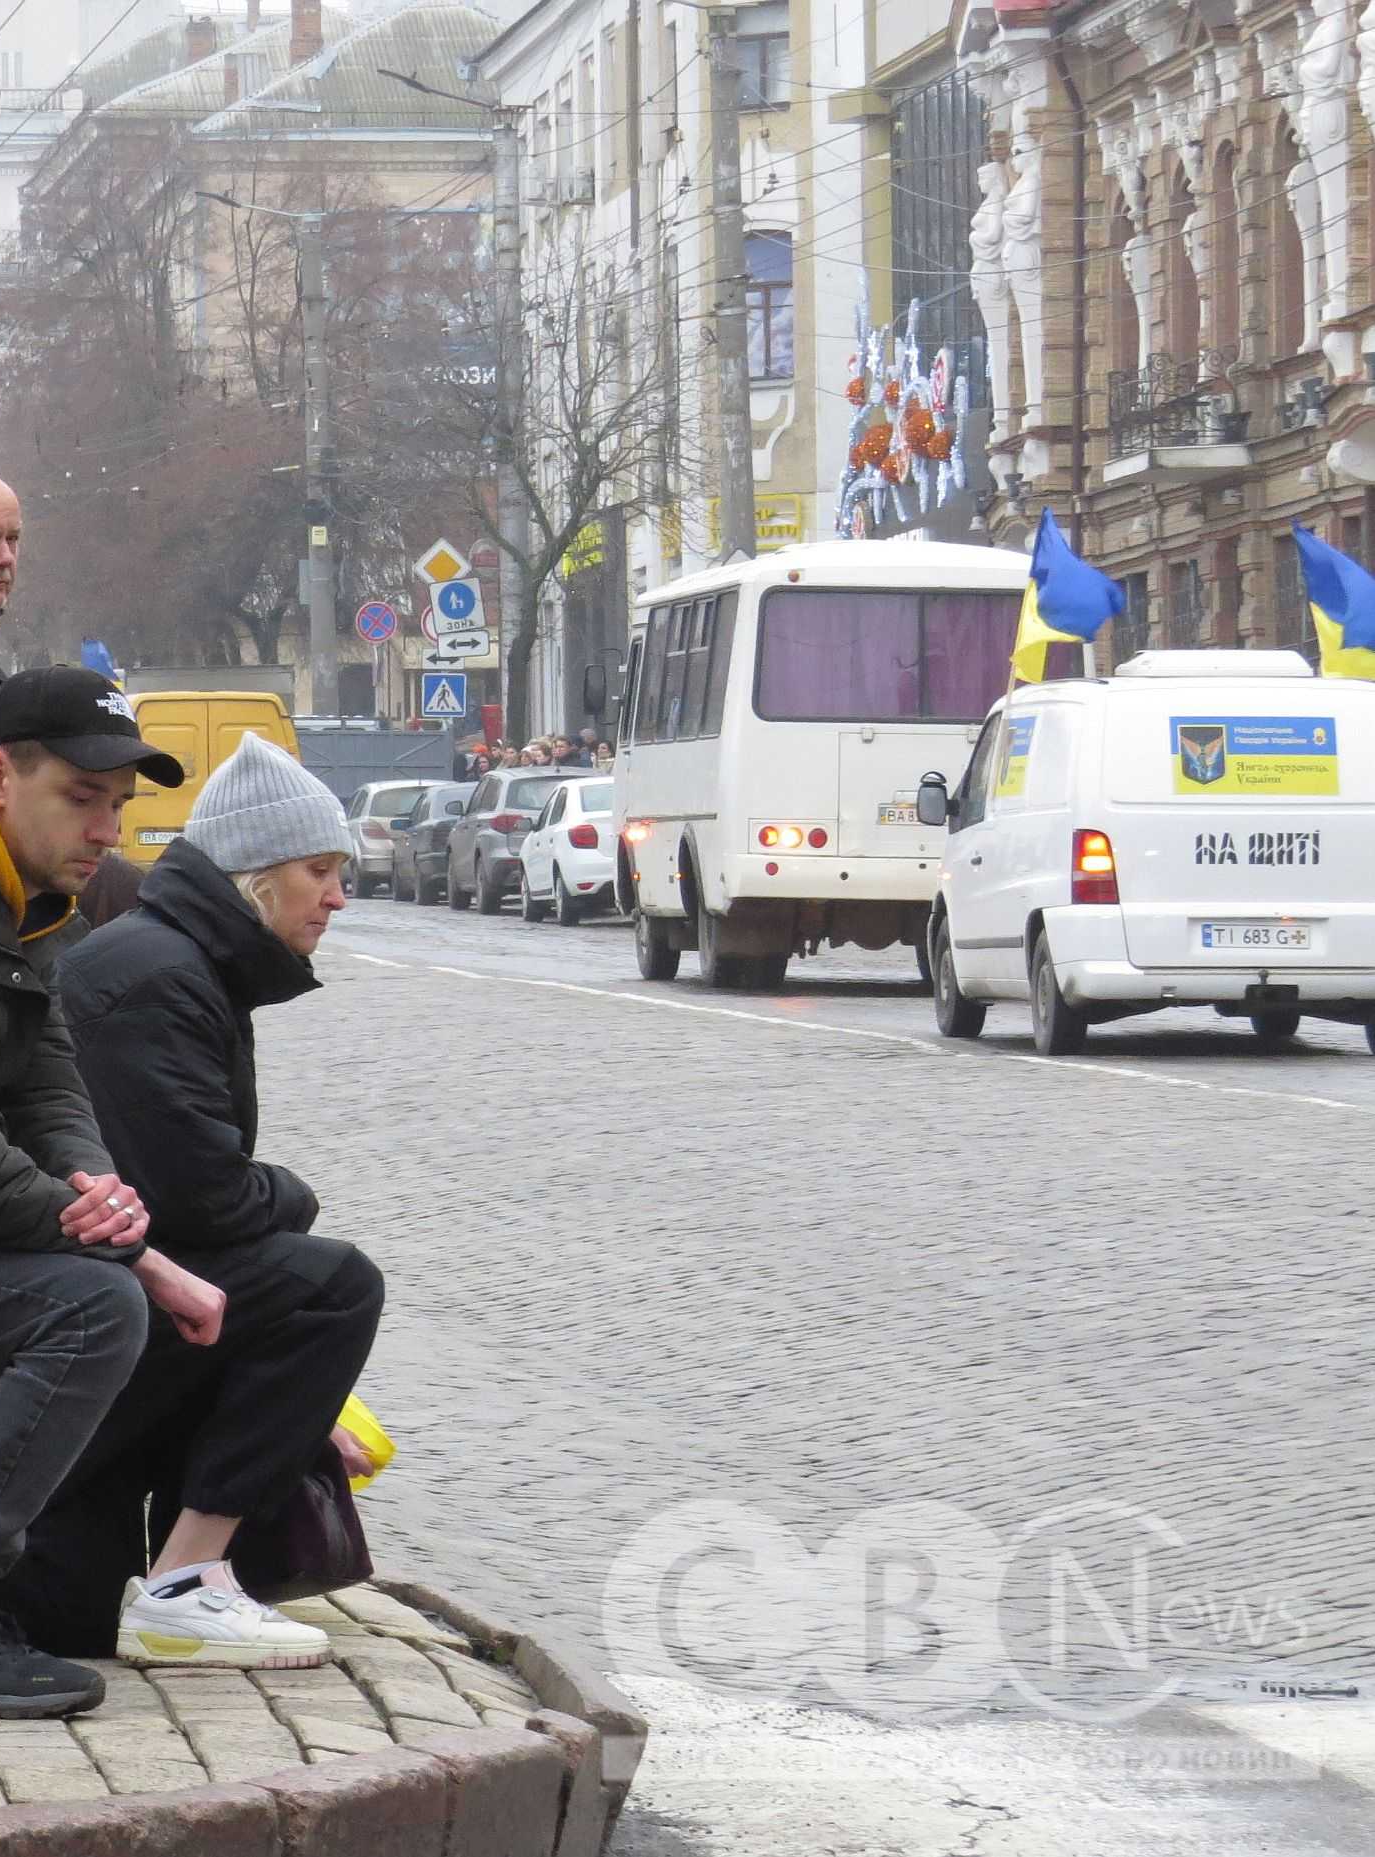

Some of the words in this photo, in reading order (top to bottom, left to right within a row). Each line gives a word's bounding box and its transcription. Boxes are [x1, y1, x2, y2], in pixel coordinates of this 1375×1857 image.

[447, 620, 475, 631] ЗОНА
[1195, 832, 1238, 865] НА
[1248, 829, 1321, 867] ЩИТІ
[1242, 929, 1271, 945] 683
